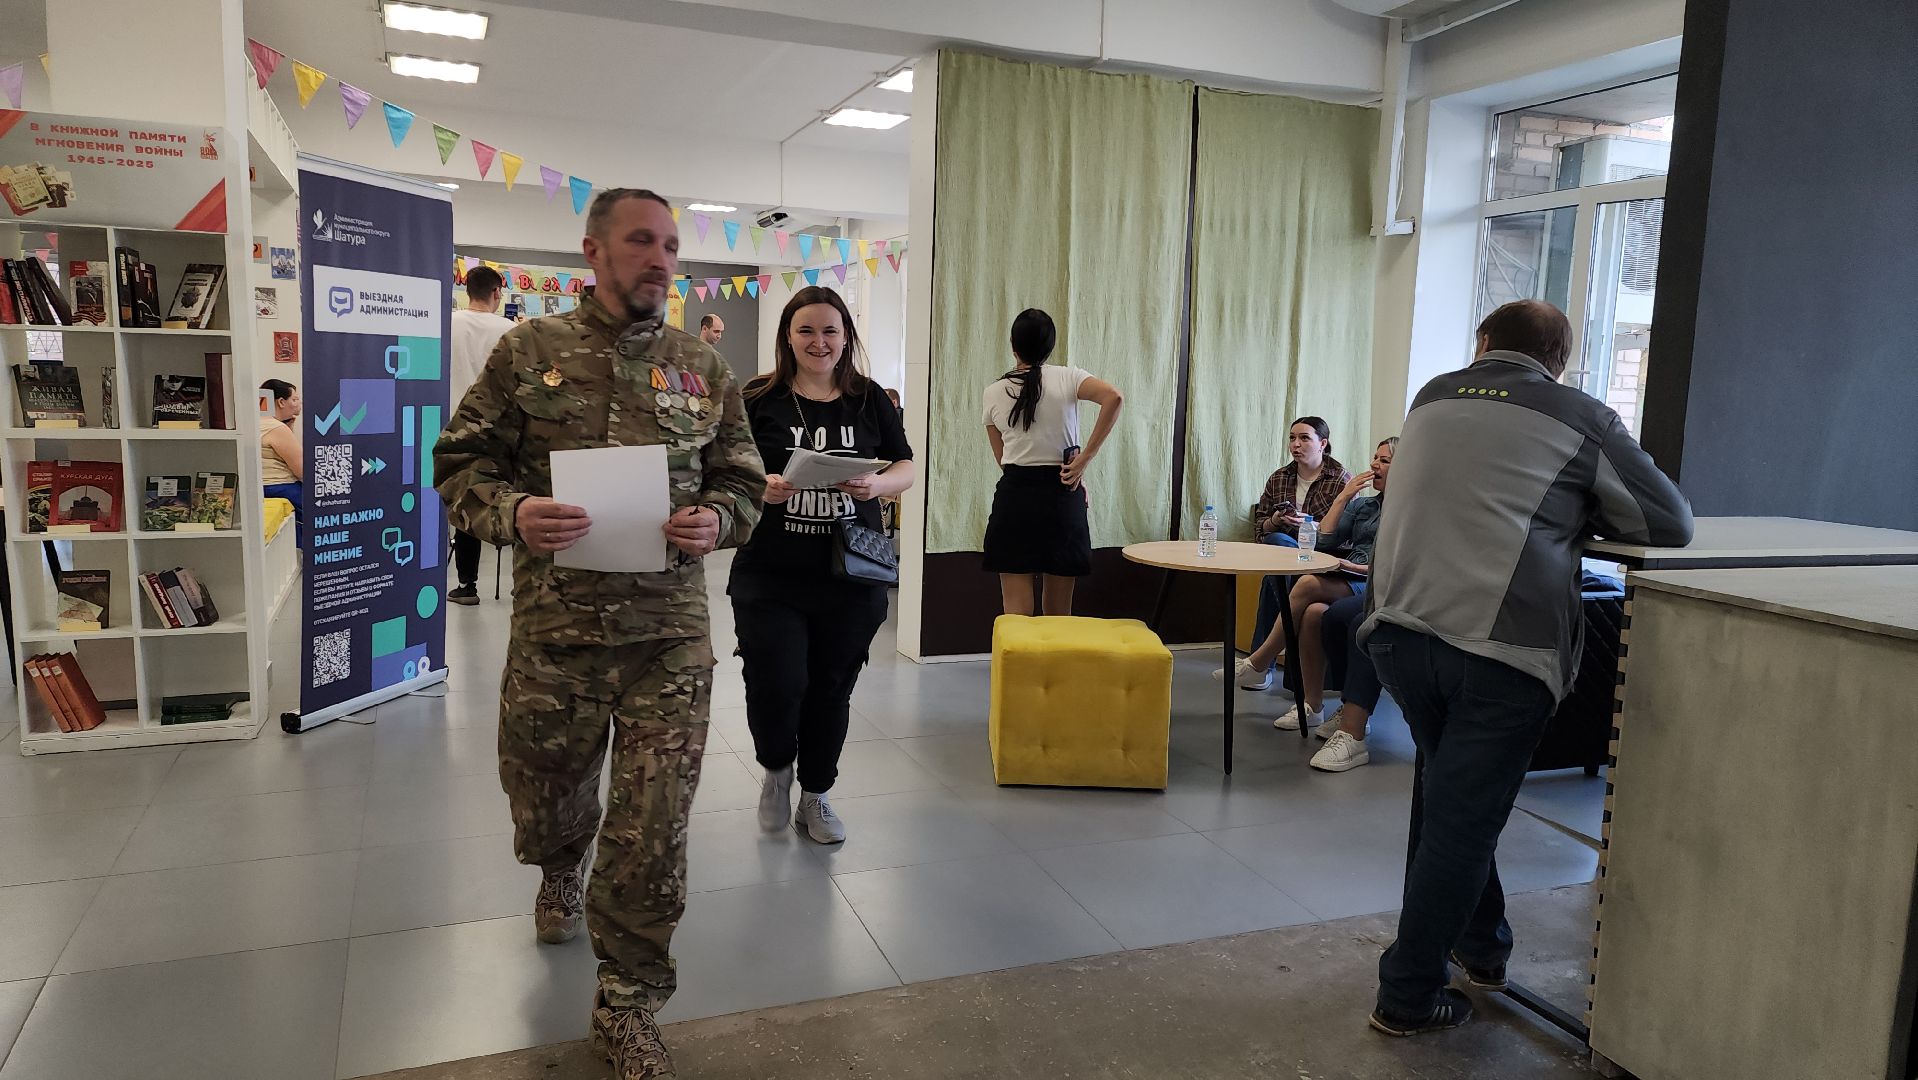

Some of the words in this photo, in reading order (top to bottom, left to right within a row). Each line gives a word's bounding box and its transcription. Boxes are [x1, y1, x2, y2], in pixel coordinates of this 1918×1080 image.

[30, 122, 39, 131] В
[50, 124, 119, 138] КНИЖНОЙ
[128, 130, 187, 143] ПАМЯТИ
[35, 138, 125, 152] МГНОВЕНИЯ
[135, 145, 184, 158] ВОЙНЫ
[67, 154, 154, 169] 1945-2025
[334, 229, 367, 247] Шатура
[359, 291, 404, 304] ВЫЕЗДНАЯ
[359, 304, 429, 318] АДМИНИСТРАЦИЯ
[29, 391, 78, 400] ПАМЯТЬ
[31, 385, 73, 393] ЖИВАЯ
[786, 490, 856, 517] UNDER
[314, 514, 340, 529] НАМ
[342, 508, 384, 525] ВАЖНО
[784, 521, 833, 535] SURVEILL
[314, 530, 350, 547] ВАШЕ
[314, 545, 363, 565] МНЕНИЕ
[339, 566, 359, 576] ВОПРОС
[359, 562, 380, 571] ОСТАЛСЯ
